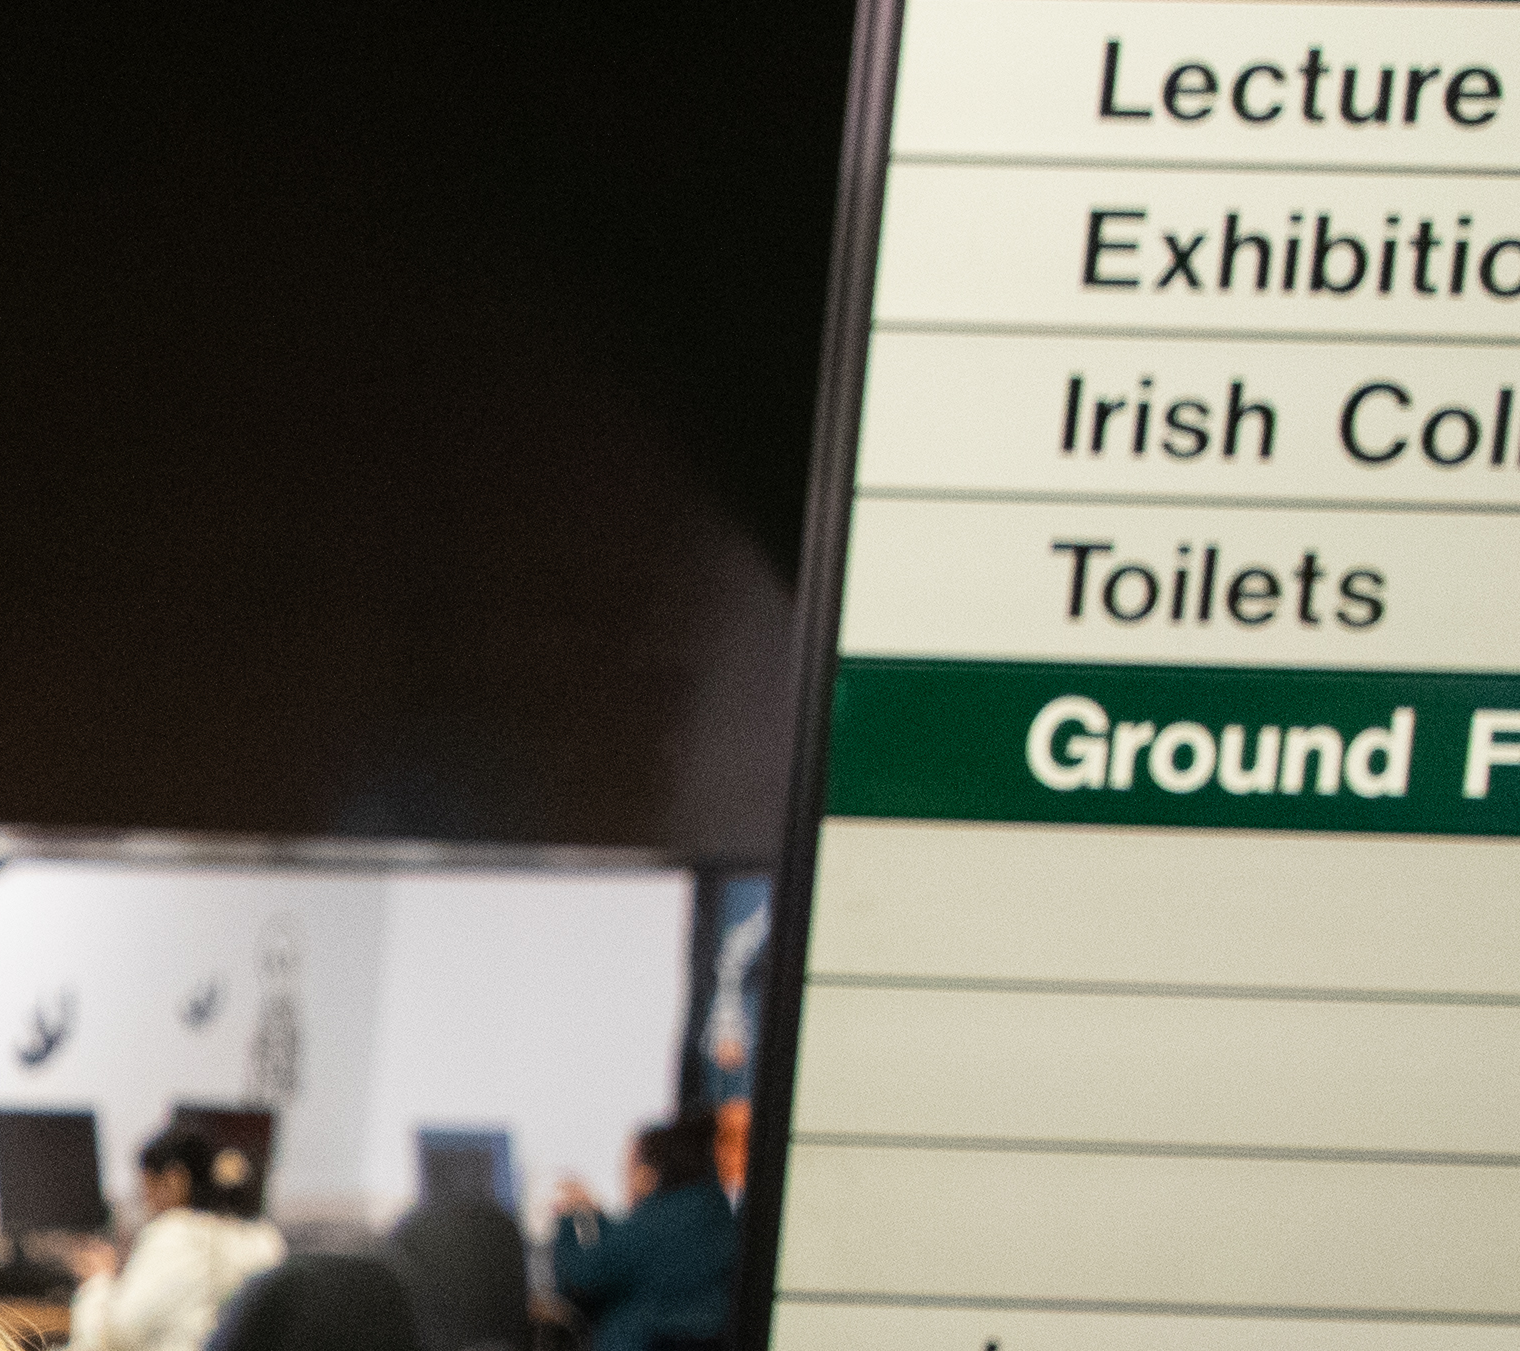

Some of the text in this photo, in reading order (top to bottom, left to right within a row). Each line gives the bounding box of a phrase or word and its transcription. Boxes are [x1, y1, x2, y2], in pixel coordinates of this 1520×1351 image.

[1095, 38, 1504, 128] Lecture
[1059, 374, 1520, 468] Irish Col
[1050, 538, 1389, 630] Toilets
[1025, 694, 1520, 800] Ground F
